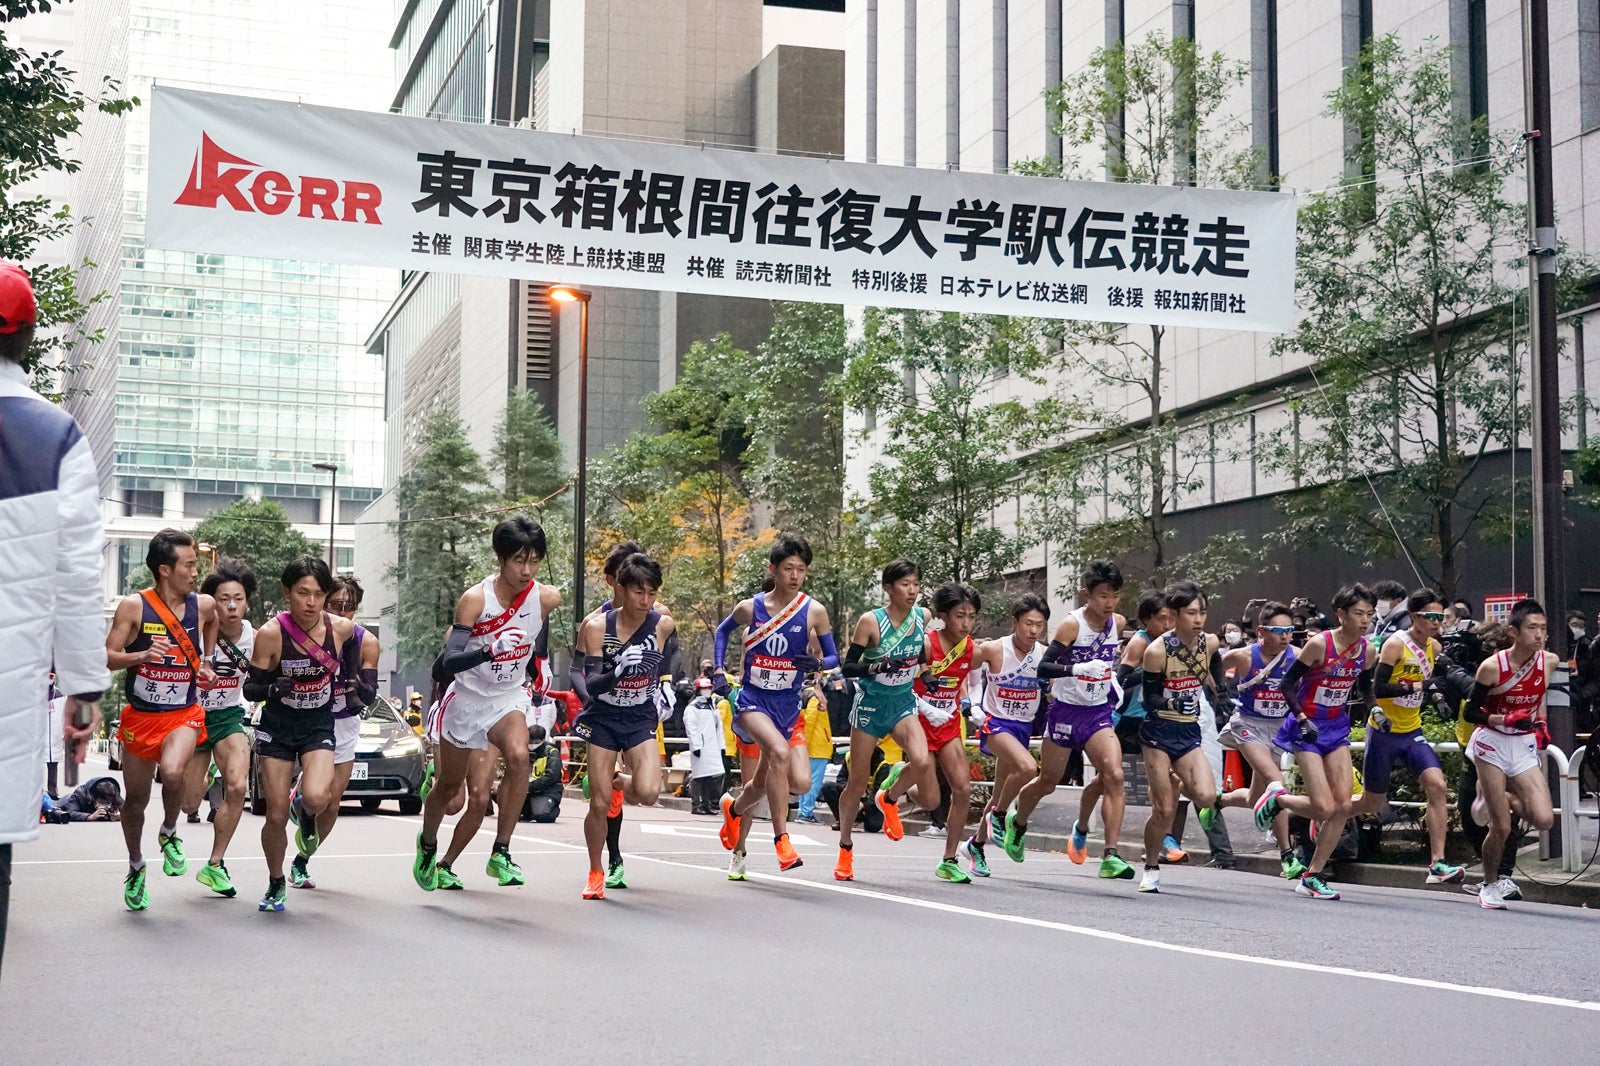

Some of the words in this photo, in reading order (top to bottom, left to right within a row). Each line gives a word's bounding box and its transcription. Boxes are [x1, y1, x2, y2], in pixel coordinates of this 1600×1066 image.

[411, 149, 1250, 278] 東京箱根間往復大学駅伝競走
[411, 231, 452, 256] 主催
[463, 236, 666, 274] 関東学生陸上競技連盟
[686, 255, 725, 279] 共催
[735, 259, 832, 287] 読売新聞社
[851, 268, 928, 295] 特別後援
[940, 275, 1088, 305] 日本テレビ放送網
[1107, 286, 1145, 308] 後援
[1154, 288, 1247, 314] 報知新聞社
[490, 660, 521, 675] 中大
[149, 668, 191, 681] SAPPORO
[760, 668, 788, 682] 順大
[617, 678, 650, 688] APPORO
[148, 692, 172, 704] 10-1
[1002, 699, 1030, 710] 日体大
